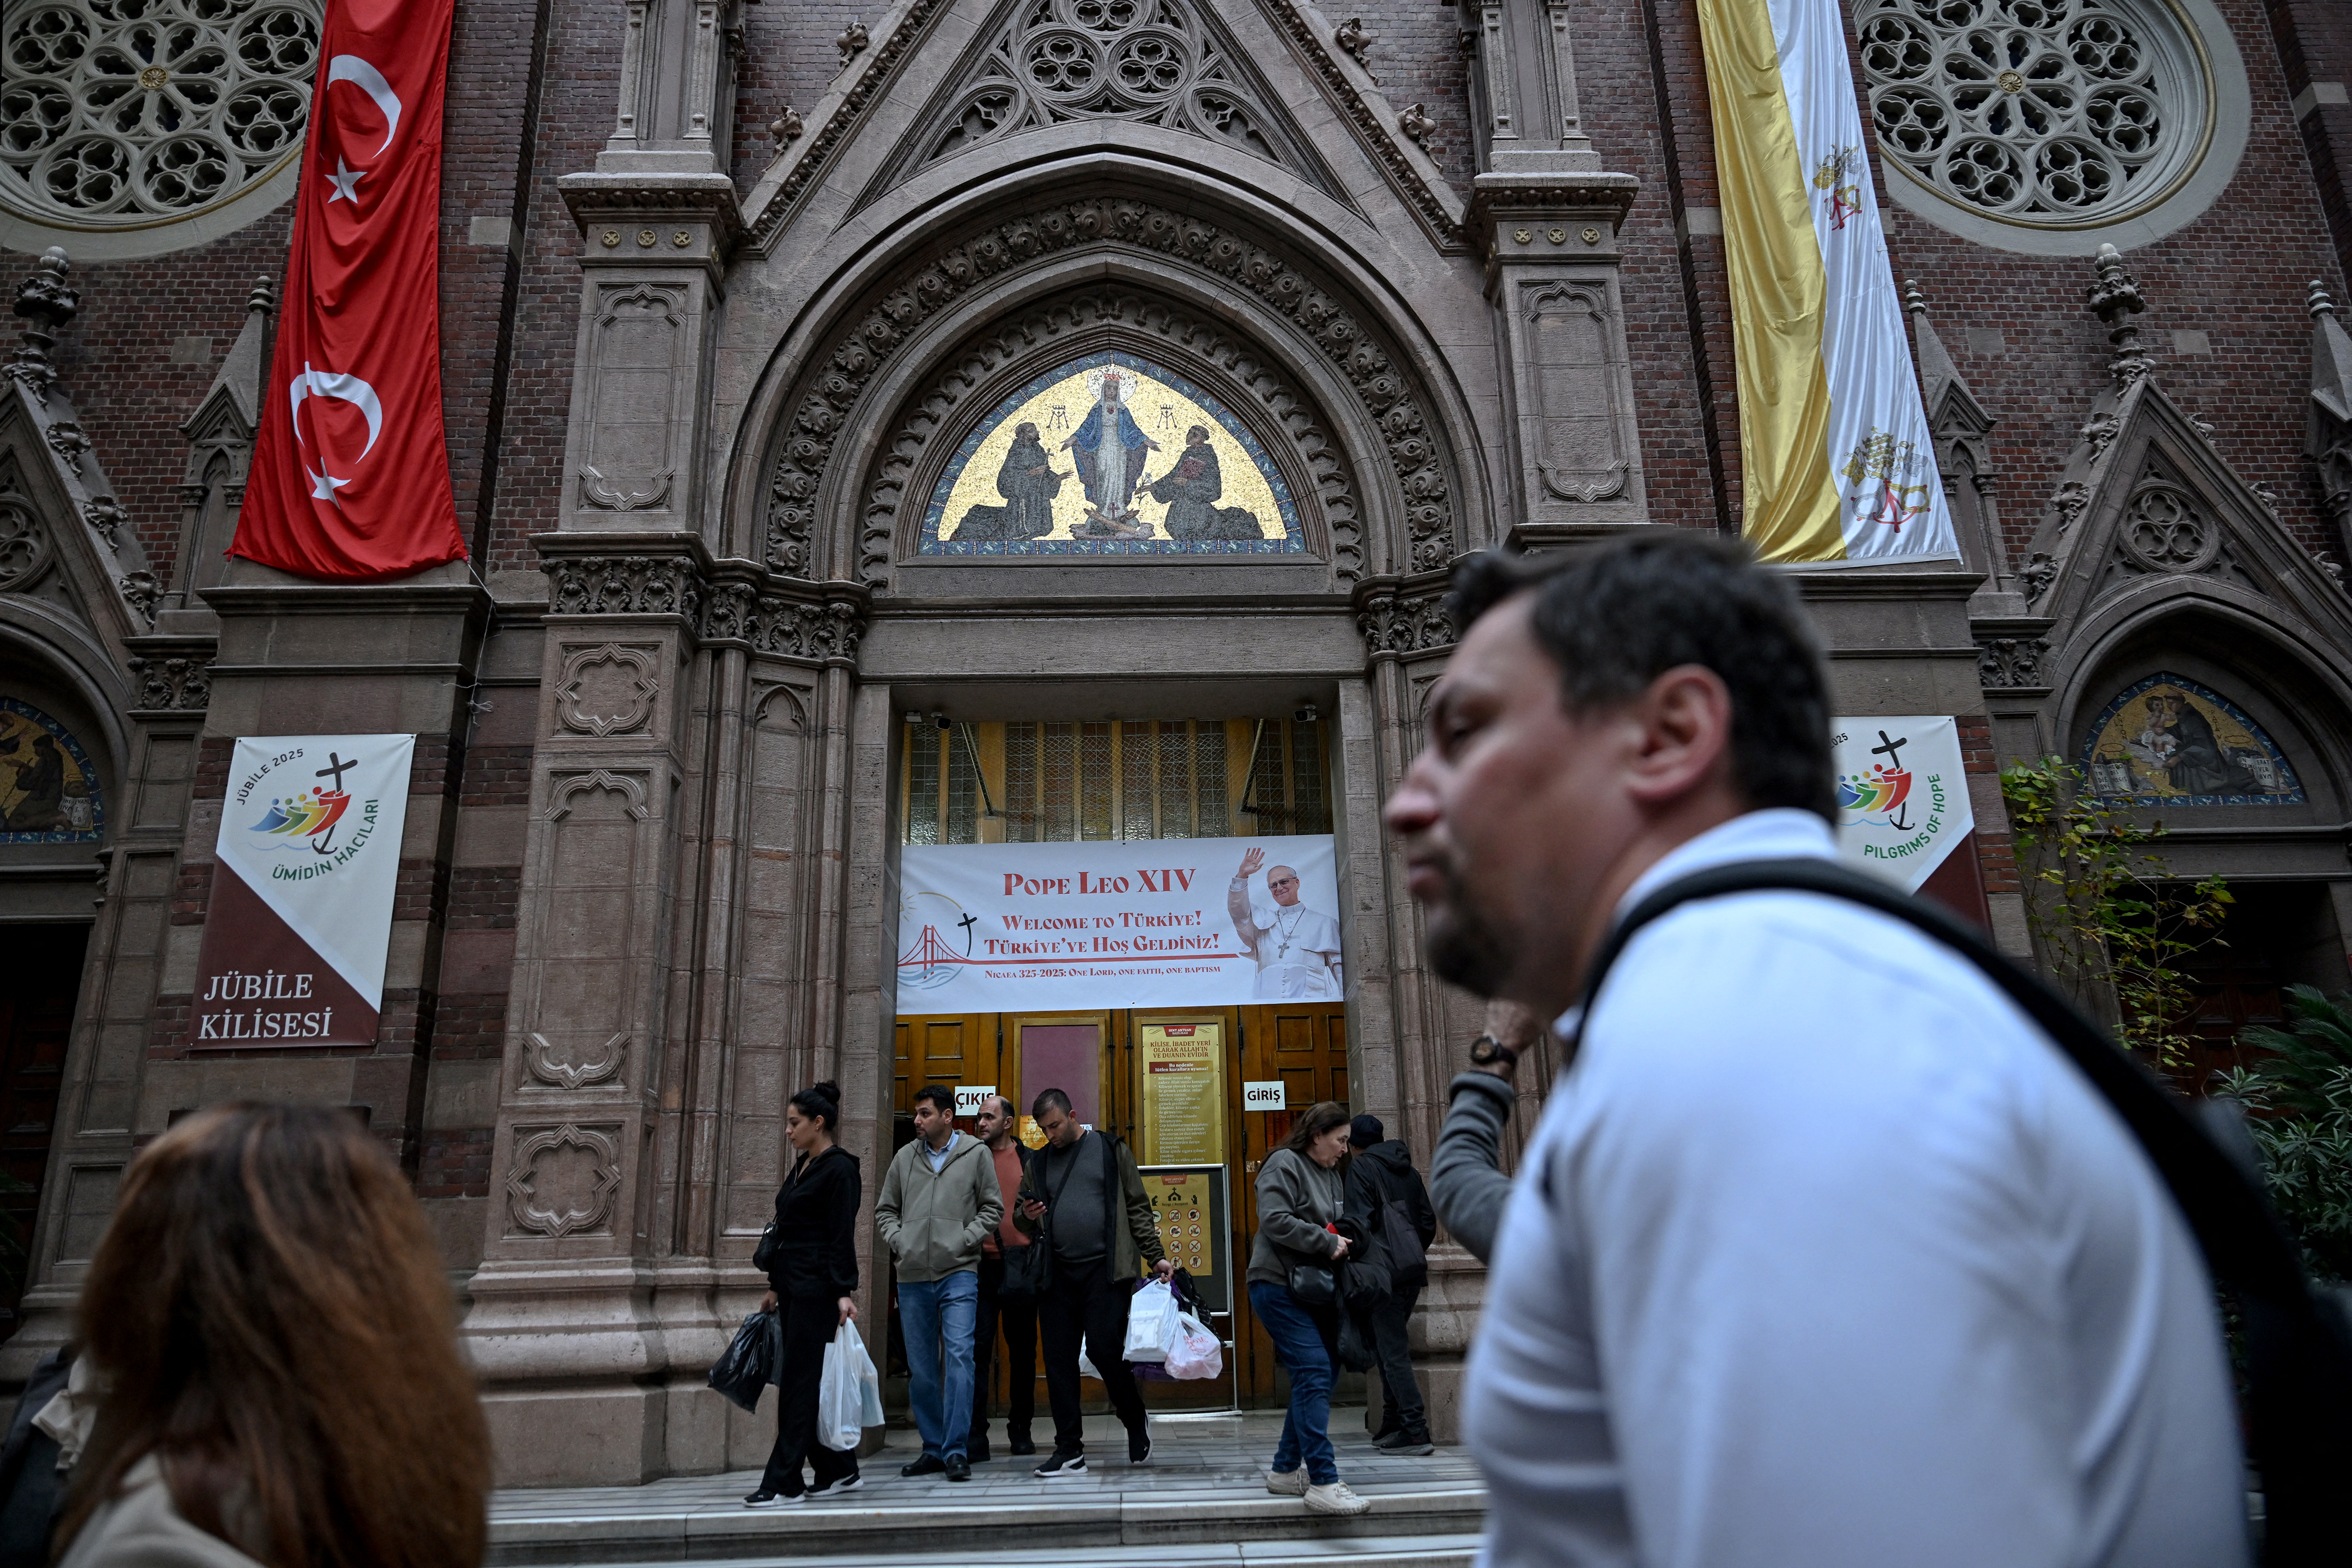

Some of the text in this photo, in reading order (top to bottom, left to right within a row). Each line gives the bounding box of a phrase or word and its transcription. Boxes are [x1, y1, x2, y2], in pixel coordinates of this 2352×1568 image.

[237, 748, 303, 805] JÜBİLE 2025
[1864, 774, 1945, 858] PILGRIMS OF HOPE
[272, 800, 378, 881] ÜMİDİN HACILARI
[1136, 869, 1196, 892] XIV
[204, 969, 313, 1000] JÜBİLE
[1019, 969, 1067, 978] 325-2025:
[198, 1007, 333, 1039] KİLİSESİ
[1247, 1088, 1280, 1103] GİRİŞ
